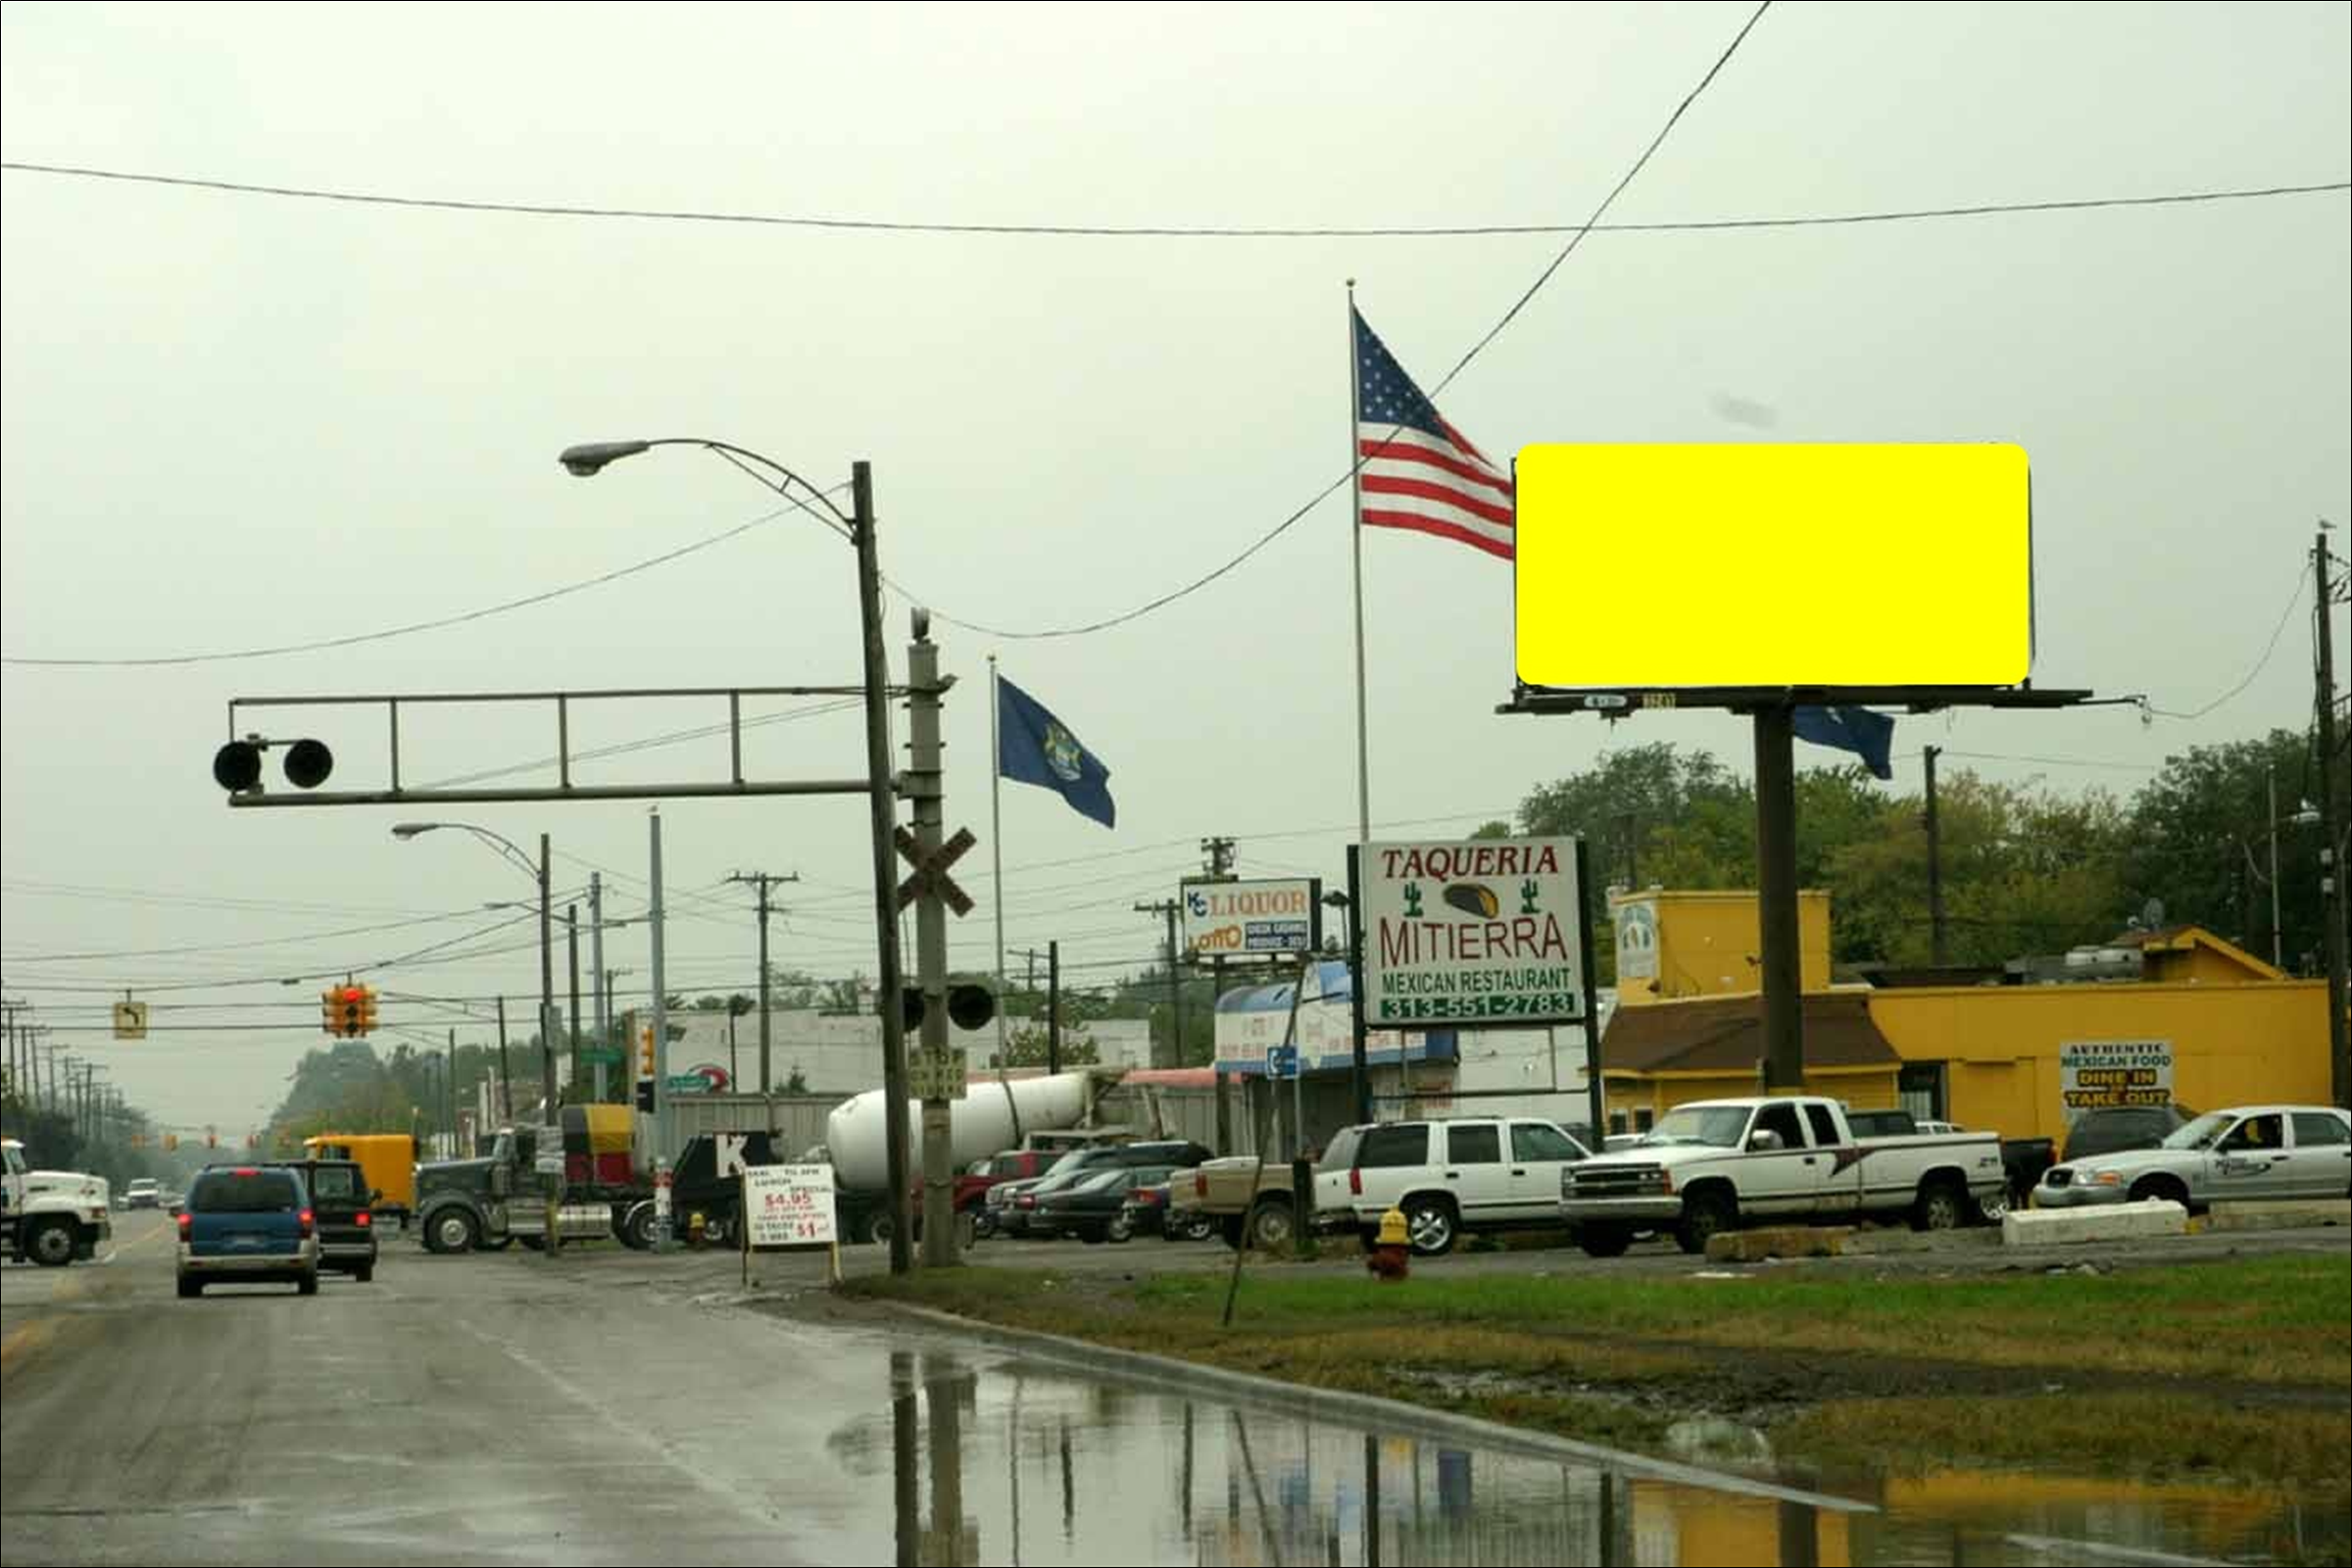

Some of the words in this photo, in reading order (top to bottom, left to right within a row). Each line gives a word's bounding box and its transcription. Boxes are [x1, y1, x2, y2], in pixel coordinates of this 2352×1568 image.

[1382, 845, 1559, 882] TAQUERIA
[1209, 890, 1307, 916] LIQUOR
[1188, 925, 1243, 950] LOTTO
[1382, 971, 1456, 996] MEXICAN
[1460, 967, 1572, 993] RESTAURANT
[1387, 994, 1571, 1018] 313-551-2783
[2061, 1055, 2127, 1068] MEXICAN
[2131, 1054, 2173, 1067] FOOD
[2070, 1043, 2165, 1055] AUTHENTIC
[2079, 1069, 2127, 1085] DINE
[2132, 1069, 2155, 1084] IN
[2066, 1091, 2121, 1106] TAKE
[2125, 1090, 2170, 1104] OUT
[715, 1134, 749, 1178] K
